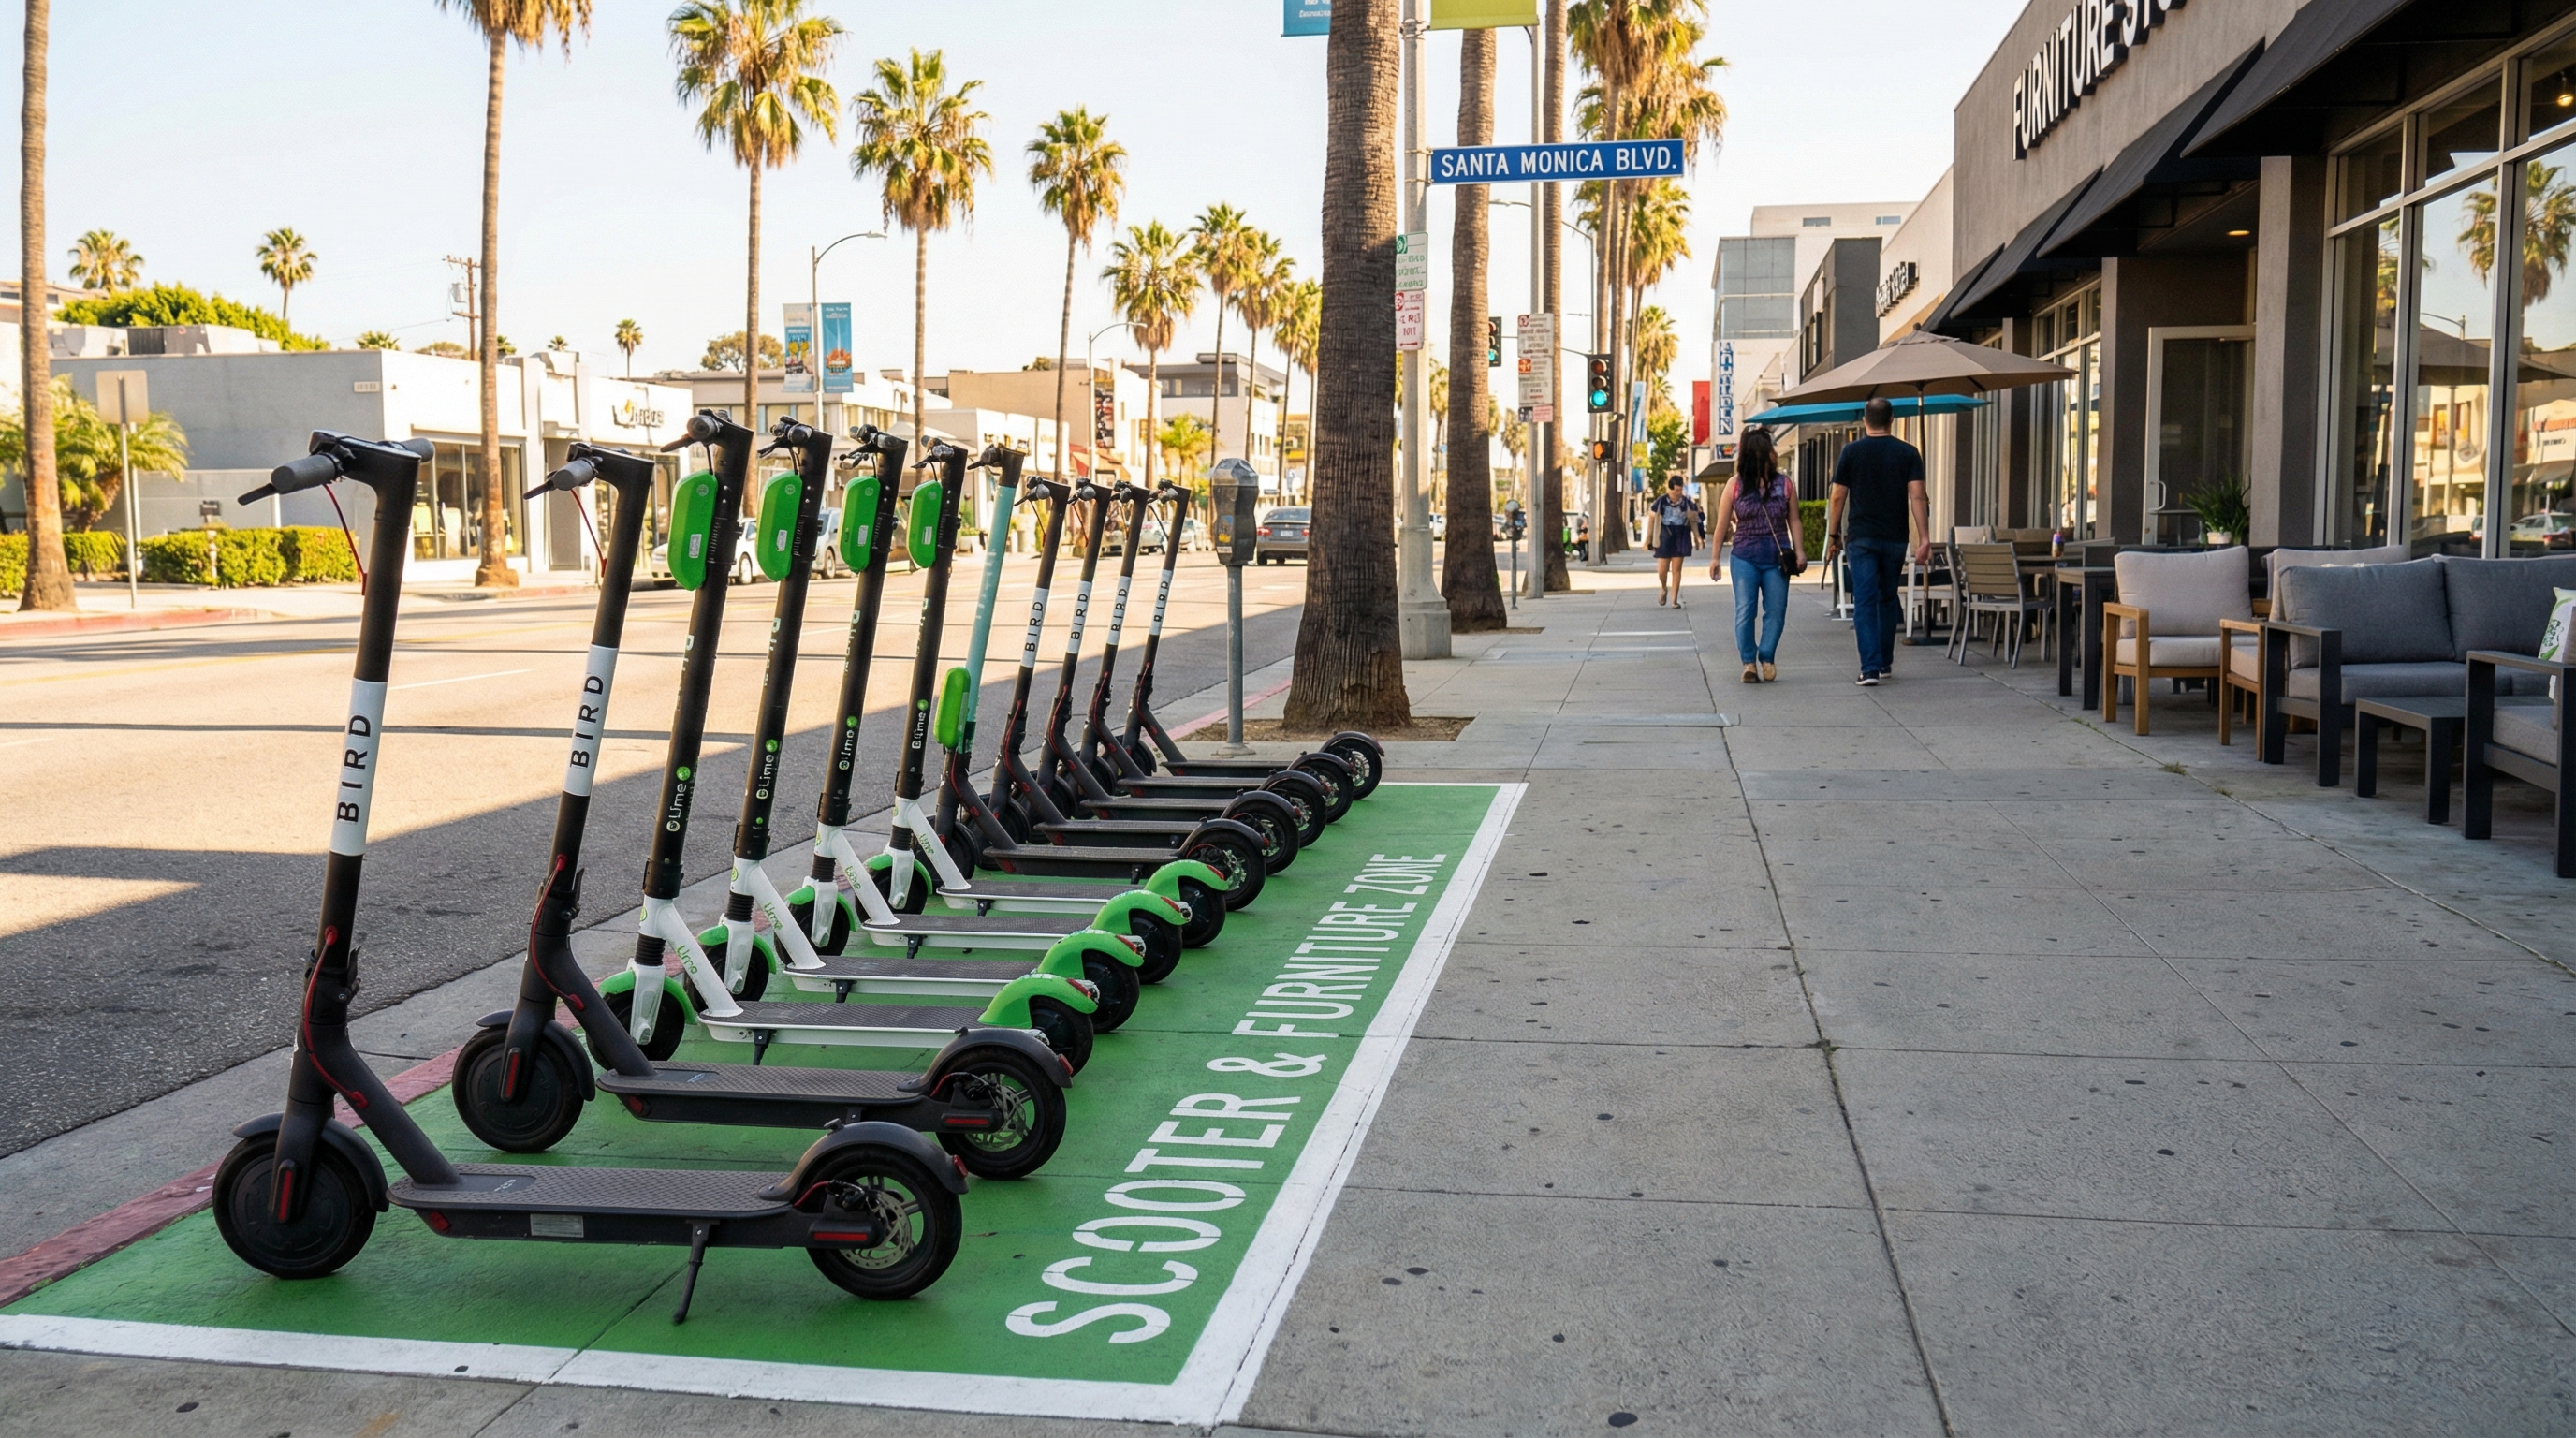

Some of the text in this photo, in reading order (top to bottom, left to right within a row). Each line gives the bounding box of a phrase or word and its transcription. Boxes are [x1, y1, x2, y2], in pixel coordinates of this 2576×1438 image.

[2013, 0, 2114, 161] FURNITURE
[1441, 146, 1676, 178] SANTA MONICA BLVD.
[1025, 601, 1043, 652] BIRD
[1071, 594, 1088, 639] BIRD
[1111, 588, 1128, 631] BIRD
[570, 675, 604, 768] BIRD
[336, 714, 371, 822] BIRD
[758, 754, 775, 788] Lime
[1005, 854, 1447, 1343] SCOOTER & FURNITURE ZONE
